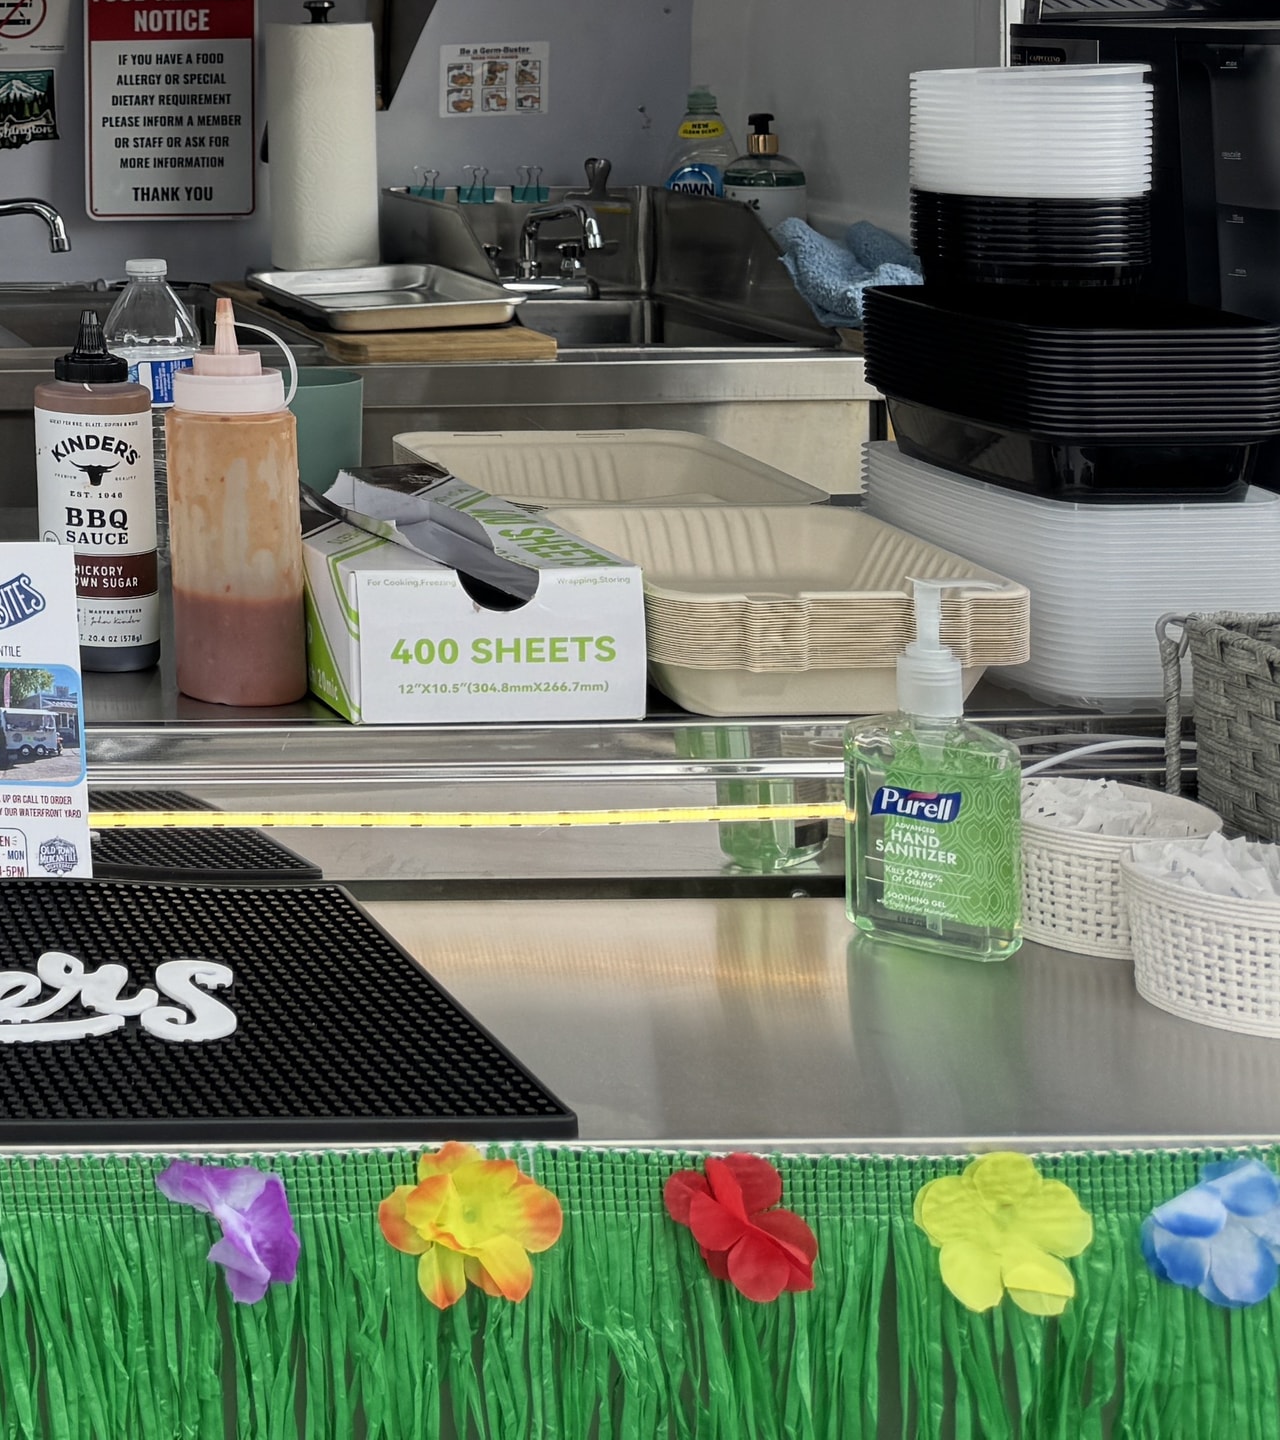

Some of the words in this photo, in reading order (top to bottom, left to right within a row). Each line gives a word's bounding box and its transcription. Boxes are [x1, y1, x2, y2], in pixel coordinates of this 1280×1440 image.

[134, 9, 210, 32] NOTICE
[460, 47, 471, 55] Be
[118, 54, 128, 66] IF
[131, 54, 152, 66] YOU
[155, 53, 183, 65] HAVE
[185, 53, 193, 65] A
[196, 52, 224, 65] FOOD
[116, 74, 161, 86] ALLERGY
[165, 74, 180, 85] OR
[183, 73, 227, 85] SPECIAL
[111, 94, 155, 107] DIETARY
[158, 93, 232, 106] REQUIREMENT
[102, 115, 140, 128] PLEASE
[143, 115, 185, 128] INFORM
[186, 115, 195, 127] A
[197, 114, 242, 127] MEMBER
[115, 137, 130, 149] OR
[132, 136, 164, 149] STAFF
[167, 136, 182, 149] OR
[184, 136, 206, 148] ASK
[209, 135, 229, 148] FOR
[120, 157, 150, 169] MORE
[153, 156, 225, 169] INFORMATION
[132, 187, 181, 202] THANK
[184, 186, 213, 201] YOU
[671, 183, 715, 195] DAWN
[51, 435, 140, 465] KINDER'S
[65, 507, 129, 531] BBQ
[66, 530, 129, 545] SAUCE
[390, 638, 460, 665] 400
[470, 635, 617, 665] SHEETS
[881, 788, 953, 821] Purell
[4, 807, 18, 816] OUR
[19, 808, 62, 817] WATERFRONT
[64, 809, 82, 818] YARD
[895, 822, 936, 834] ADVANCED
[891, 829, 940, 848] HAND
[875, 839, 957, 865] SANITIZER
